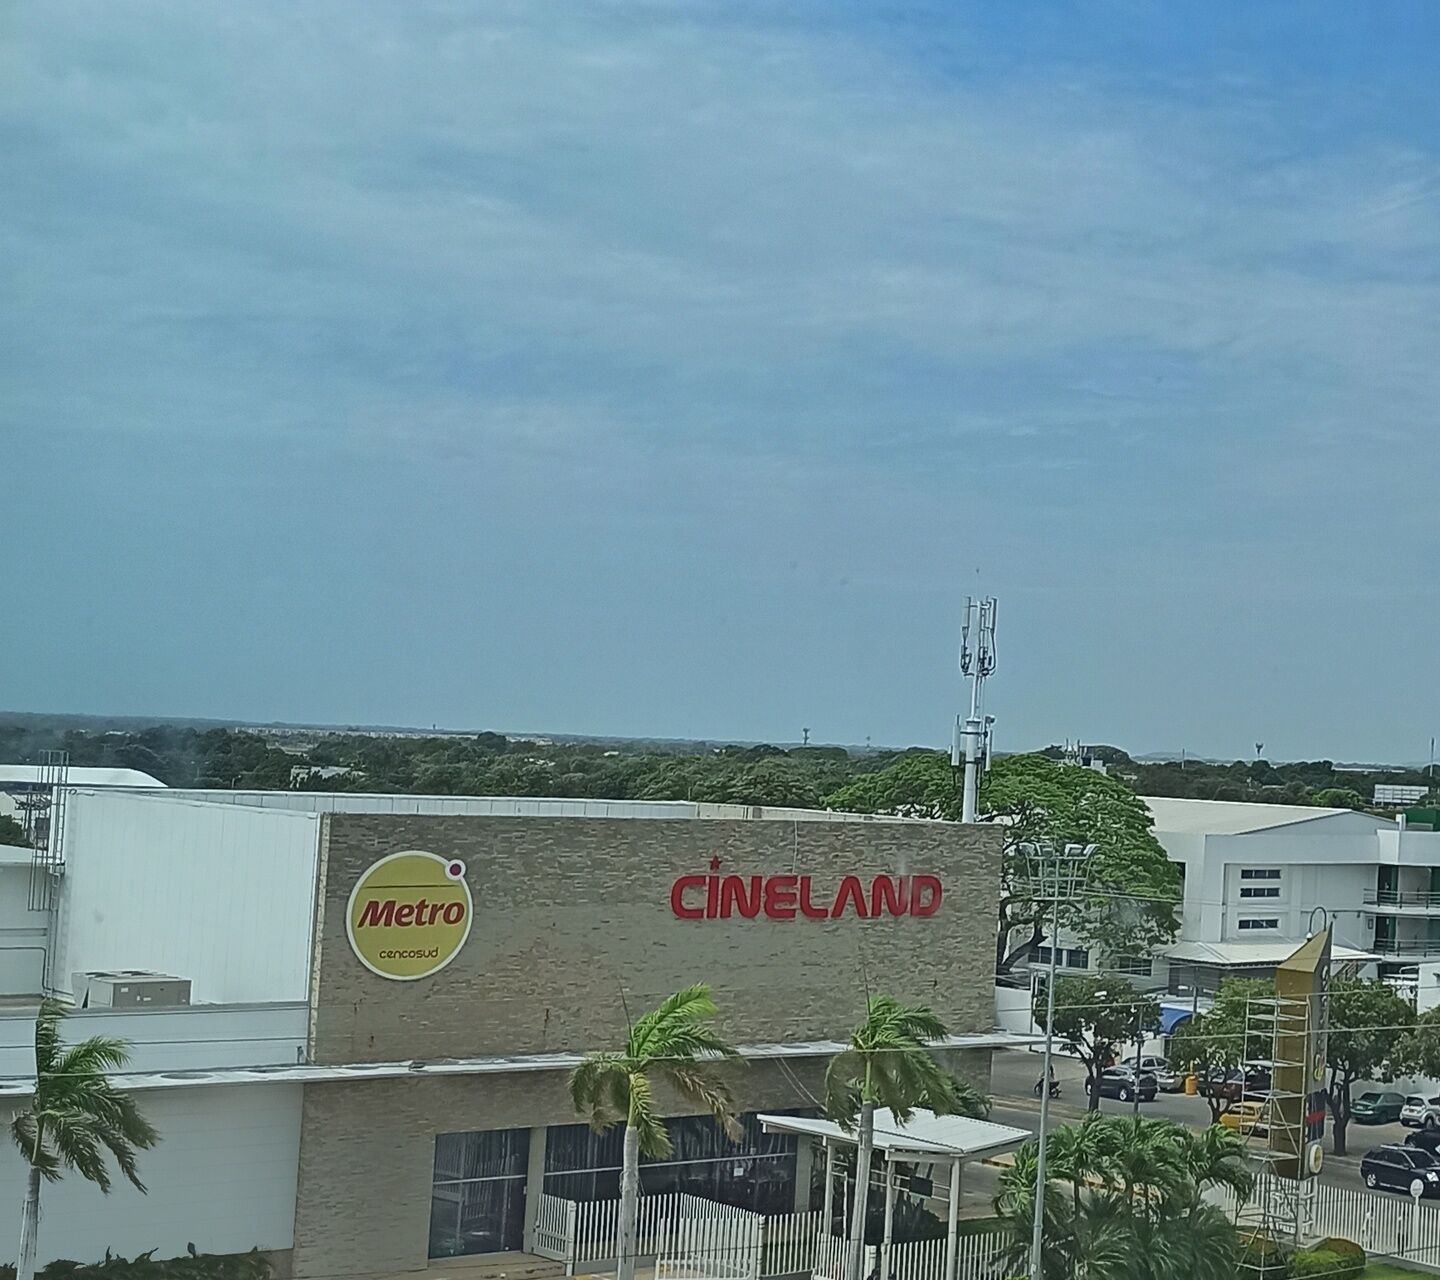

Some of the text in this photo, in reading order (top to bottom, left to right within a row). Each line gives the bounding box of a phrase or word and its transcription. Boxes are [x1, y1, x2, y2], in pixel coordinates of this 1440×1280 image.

[670, 856, 943, 919] CINELAND
[357, 898, 465, 928] Metro
[379, 946, 439, 959] cencosud
